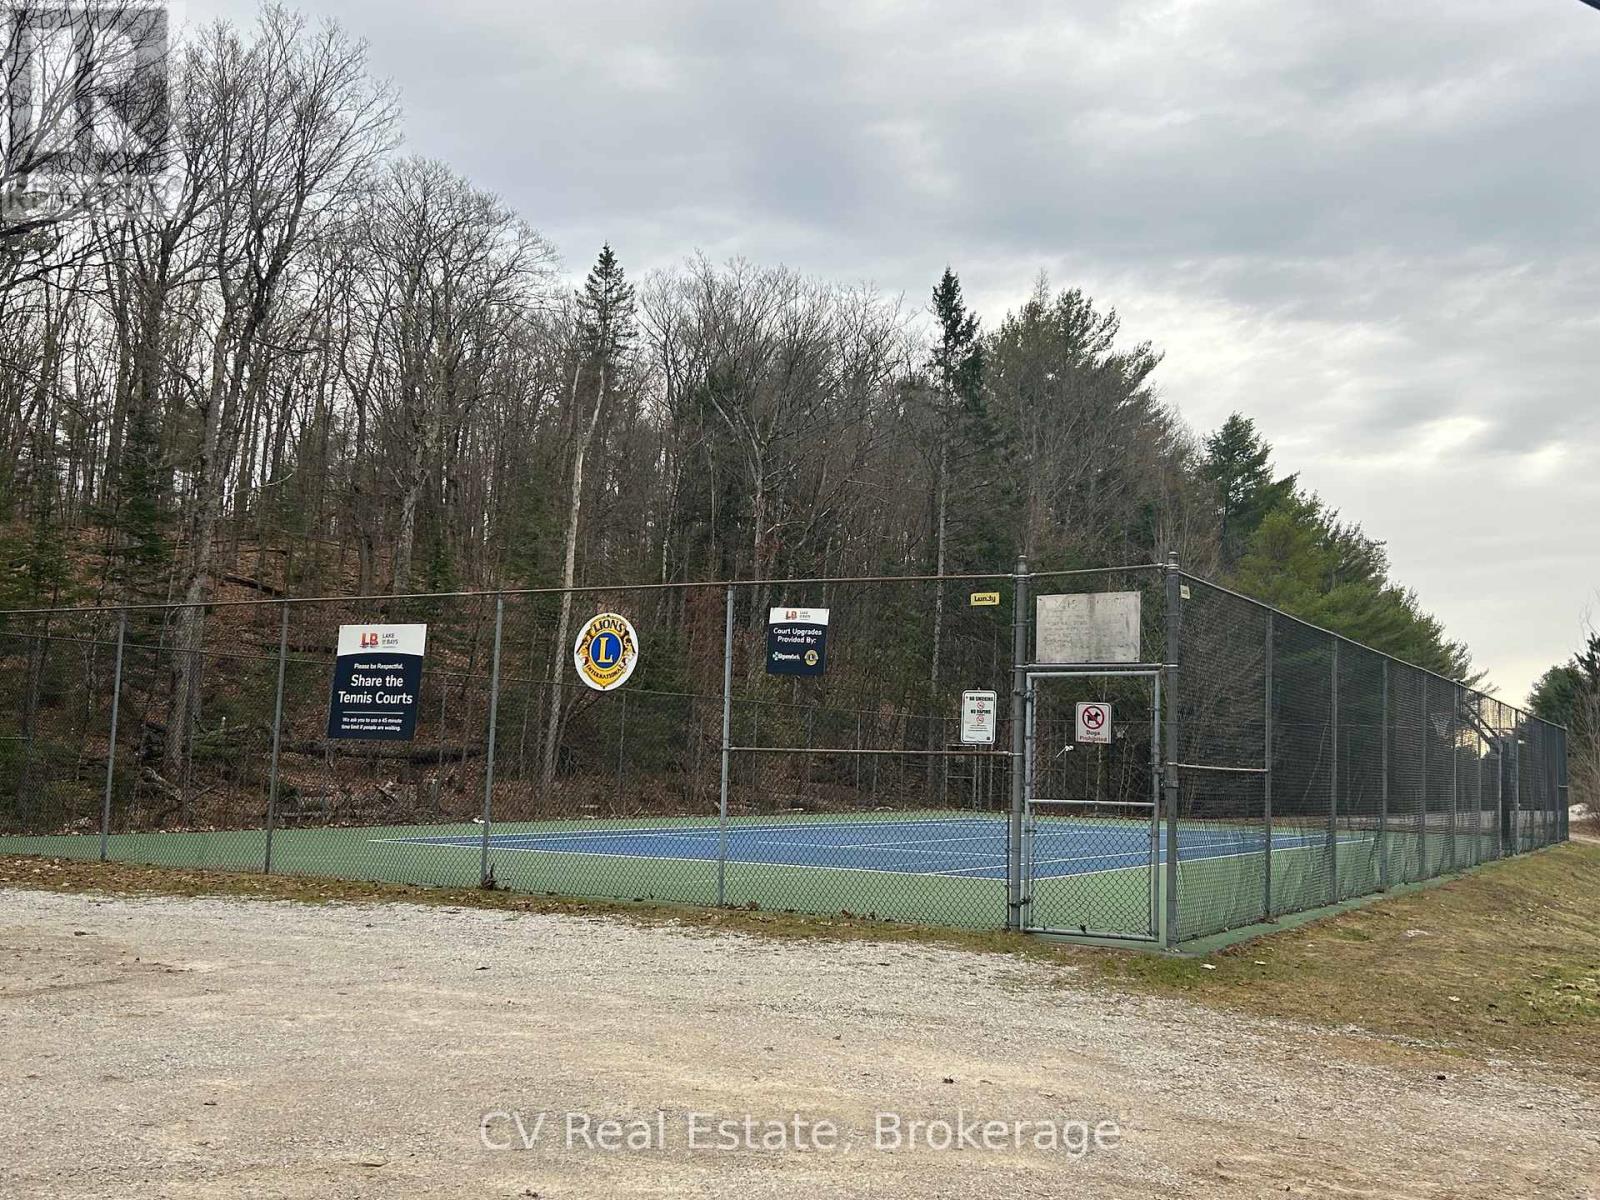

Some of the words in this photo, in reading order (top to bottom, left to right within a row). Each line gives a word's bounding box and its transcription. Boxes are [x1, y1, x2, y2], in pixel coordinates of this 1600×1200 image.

[593, 619, 625, 632] LIONS
[773, 627, 791, 635] Court
[792, 628, 822, 637] Upgrades
[361, 632, 379, 647] LB
[597, 637, 613, 662] L
[586, 664, 625, 679] INTERNATIONAL
[350, 674, 383, 687] Share
[385, 674, 404, 687] the
[338, 690, 373, 704] Tennis
[375, 691, 413, 704] Courts
